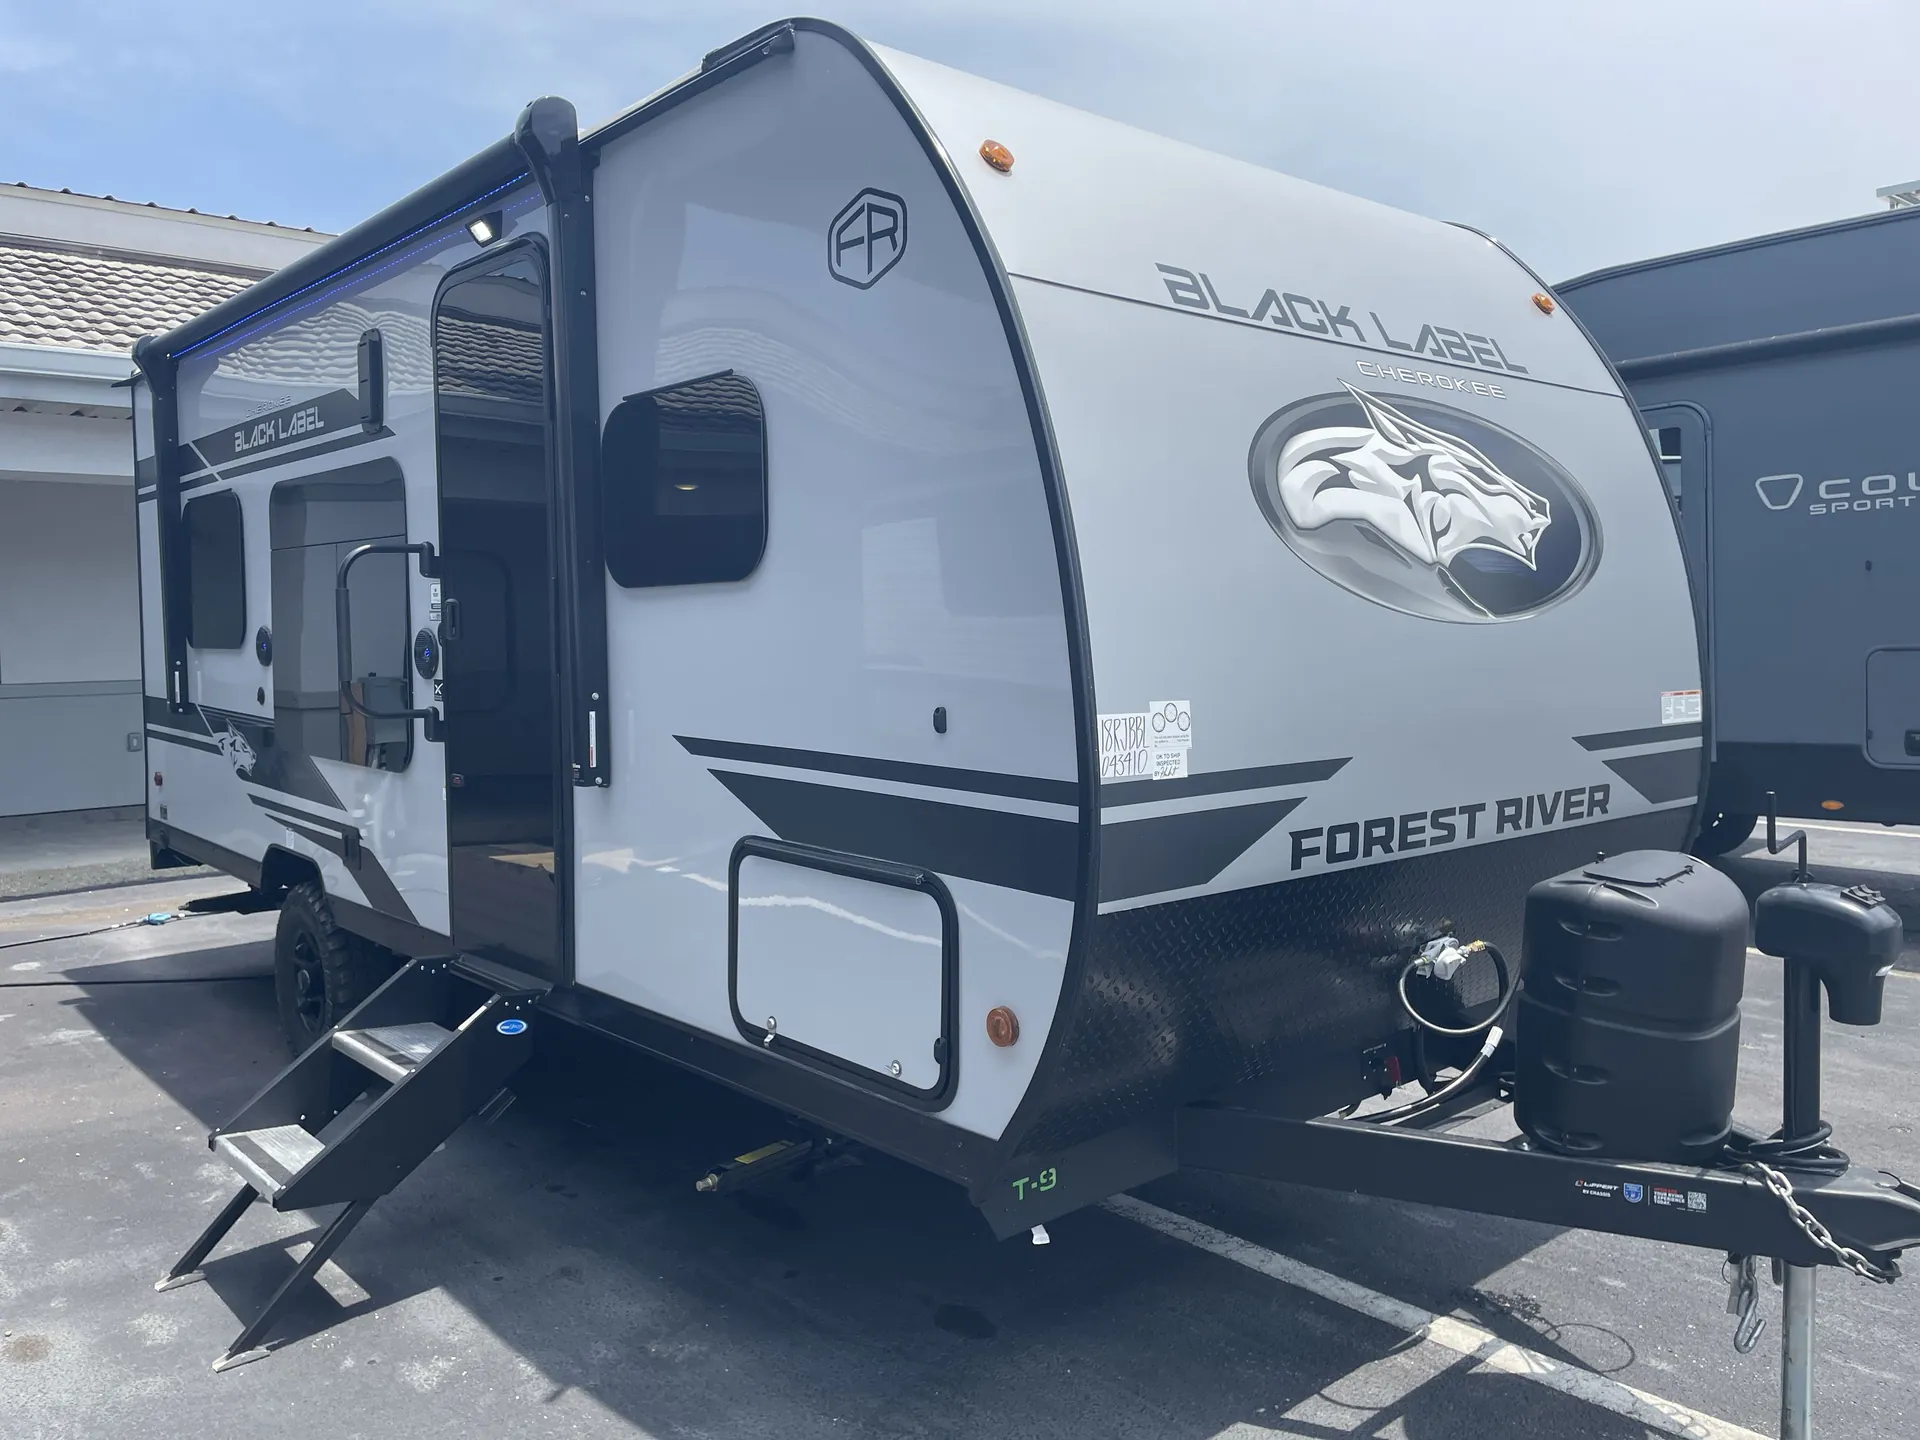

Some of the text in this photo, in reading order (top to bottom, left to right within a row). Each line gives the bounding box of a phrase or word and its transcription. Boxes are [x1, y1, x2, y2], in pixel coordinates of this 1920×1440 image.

[1155, 262, 1530, 374] BLACK LABEL
[1356, 360, 1507, 400] CHEROKEE
[246, 394, 292, 419] CHEROKEE
[234, 406, 325, 453] BLACK LABEL
[1809, 496, 1916, 515] SPORT
[1101, 749, 1148, 777] 043410
[1156, 759, 1181, 767] INSPECTED
[1289, 784, 1611, 872] FOREST RIVER
